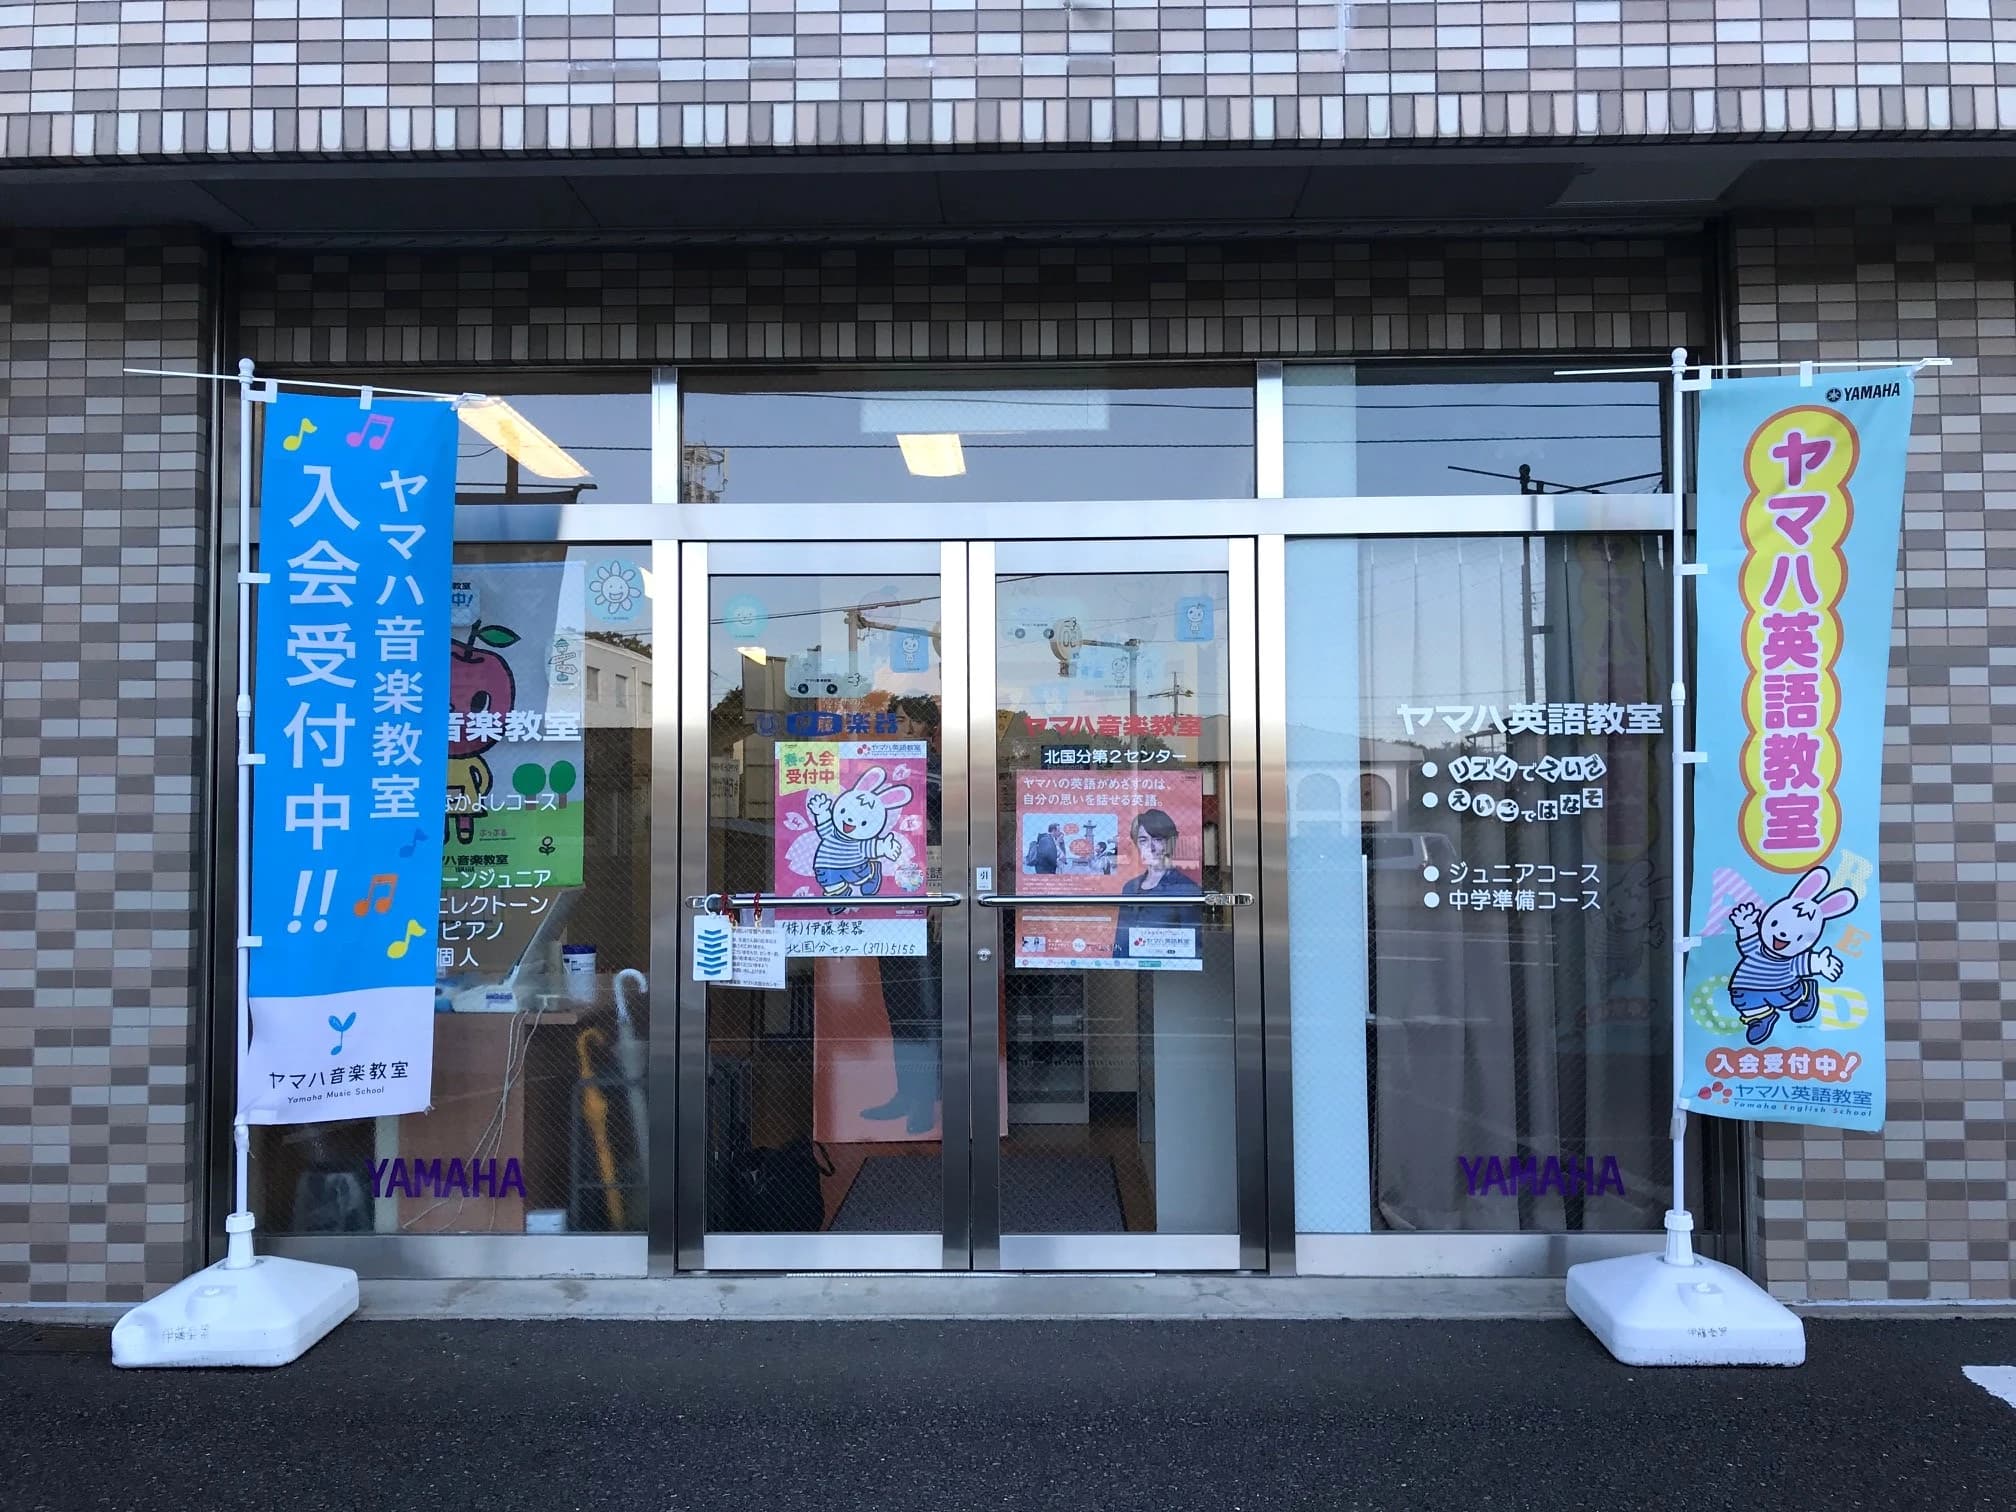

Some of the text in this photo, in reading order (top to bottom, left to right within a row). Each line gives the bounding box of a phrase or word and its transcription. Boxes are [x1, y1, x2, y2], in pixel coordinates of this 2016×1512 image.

[1844, 382, 1900, 401] YAMAHA
[370, 469, 429, 818] ヤマハ音楽教室
[1763, 432, 1831, 850] ヤマハ英語教室
[1023, 714, 1204, 737] ヤマハ音楽教室
[1397, 702, 1664, 735] ヤマハ英語教室
[1044, 749, 1187, 764] 北国分第2センター
[786, 769, 834, 784] 受付中
[1448, 754, 1607, 783] リズムでえいご
[1448, 788, 1604, 822] えいごではなそ
[442, 854, 509, 865] ハ音楽教室
[1449, 861, 1601, 884] ジュニアコース
[1449, 889, 1601, 911] 中学準備コース
[442, 920, 504, 940] ピアノ
[269, 1061, 409, 1089] ヤマハ音楽教室
[1713, 1053, 1858, 1079] 入会受付中!
[287, 1086, 385, 1104] Yamaha Music School
[1735, 1084, 1873, 1106] ヤマハ英語教室
[1734, 1101, 1873, 1117] Yamaha English School
[367, 1158, 527, 1198] YAMAHA
[1457, 1156, 1625, 1196] YAMAHA
